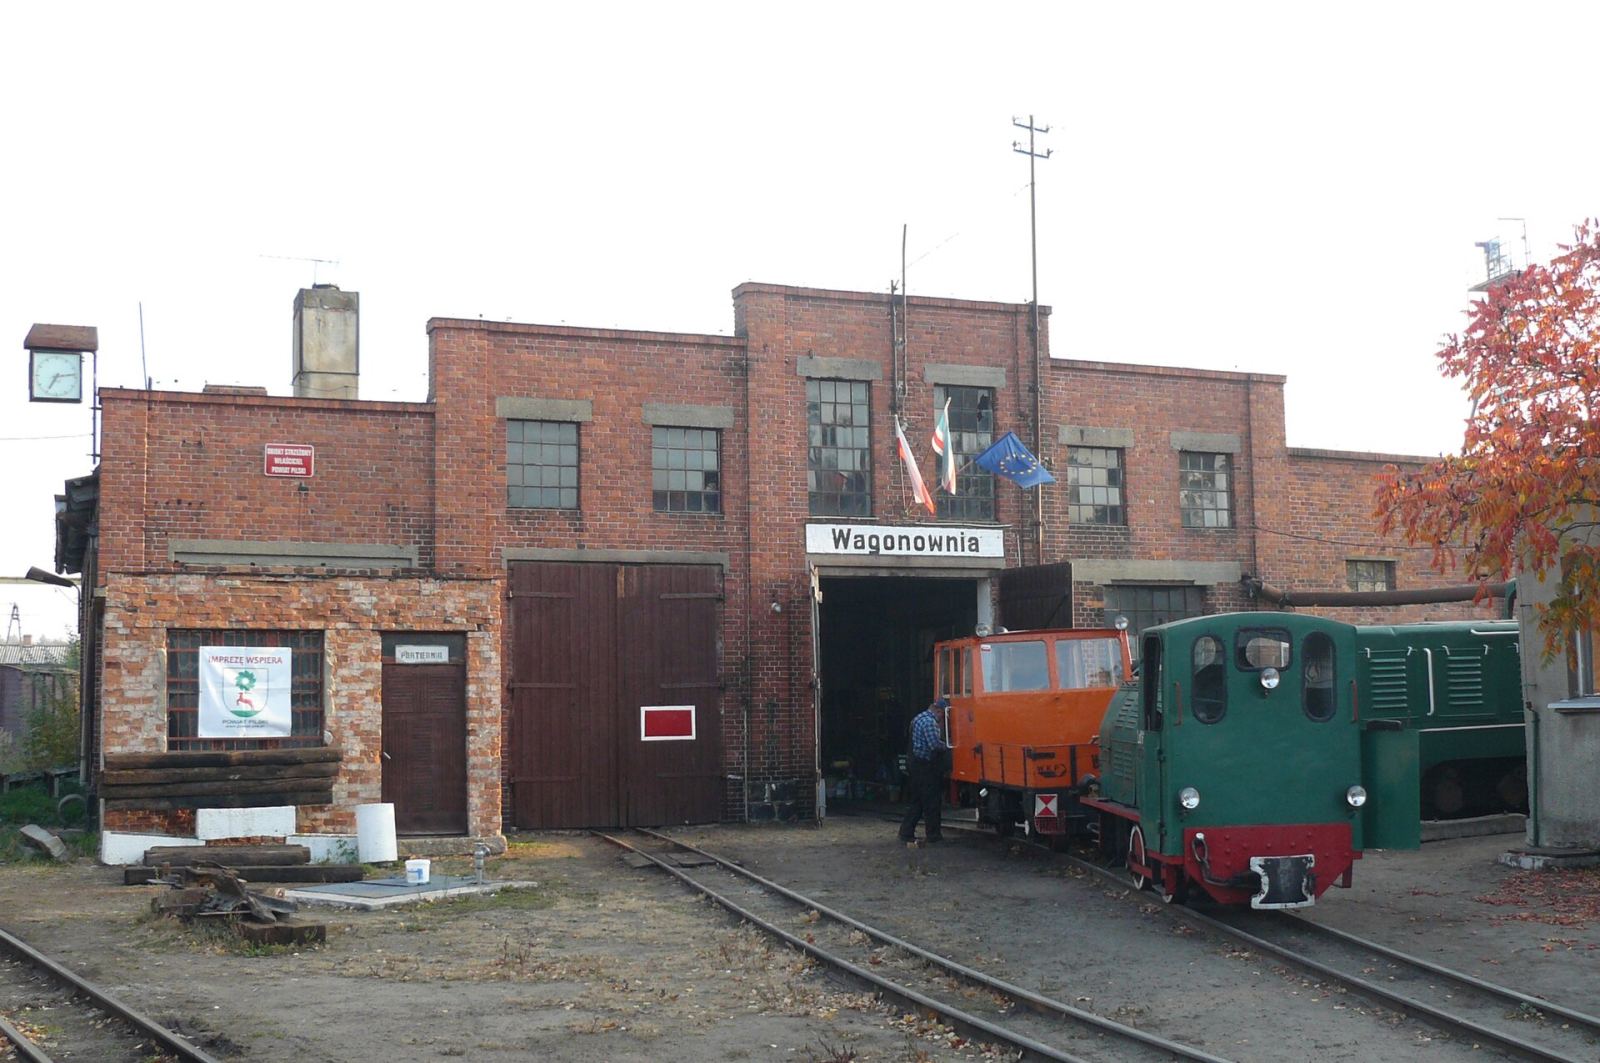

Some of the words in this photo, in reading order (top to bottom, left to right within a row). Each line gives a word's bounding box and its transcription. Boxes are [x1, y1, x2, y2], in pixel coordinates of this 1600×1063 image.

[832, 528, 979, 554] Wagonownia
[208, 655, 244, 665] IMPREZĘ
[245, 656, 282, 664] WSPIERA
